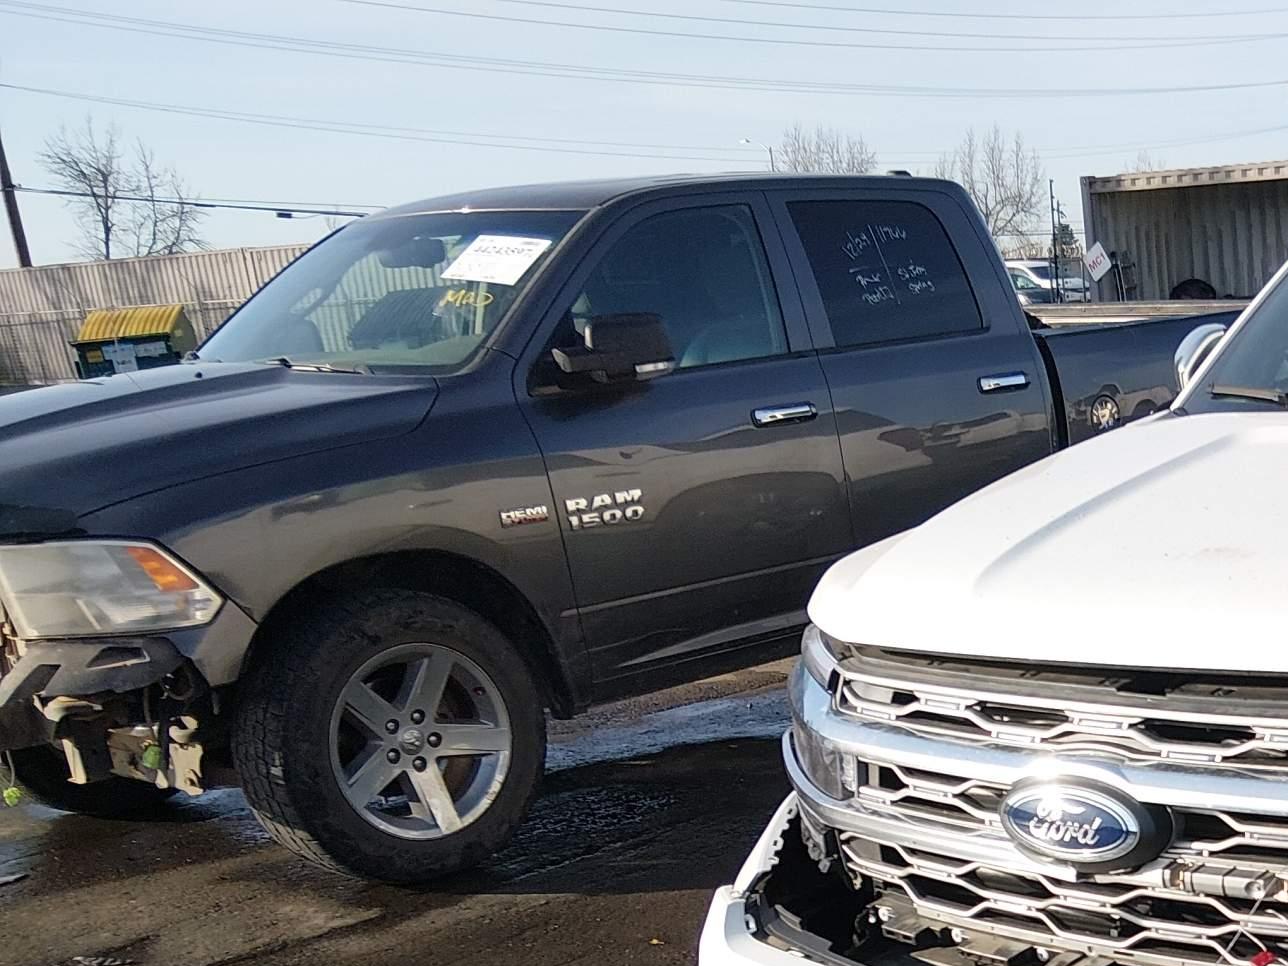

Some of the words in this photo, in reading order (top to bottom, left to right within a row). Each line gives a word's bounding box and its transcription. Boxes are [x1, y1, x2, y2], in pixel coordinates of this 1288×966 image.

[1088, 252, 1106, 273] MC1
[565, 488, 643, 512] RAM
[500, 505, 549, 521] HEMI
[567, 505, 645, 531] 1500
[1029, 797, 1103, 845] Ford
